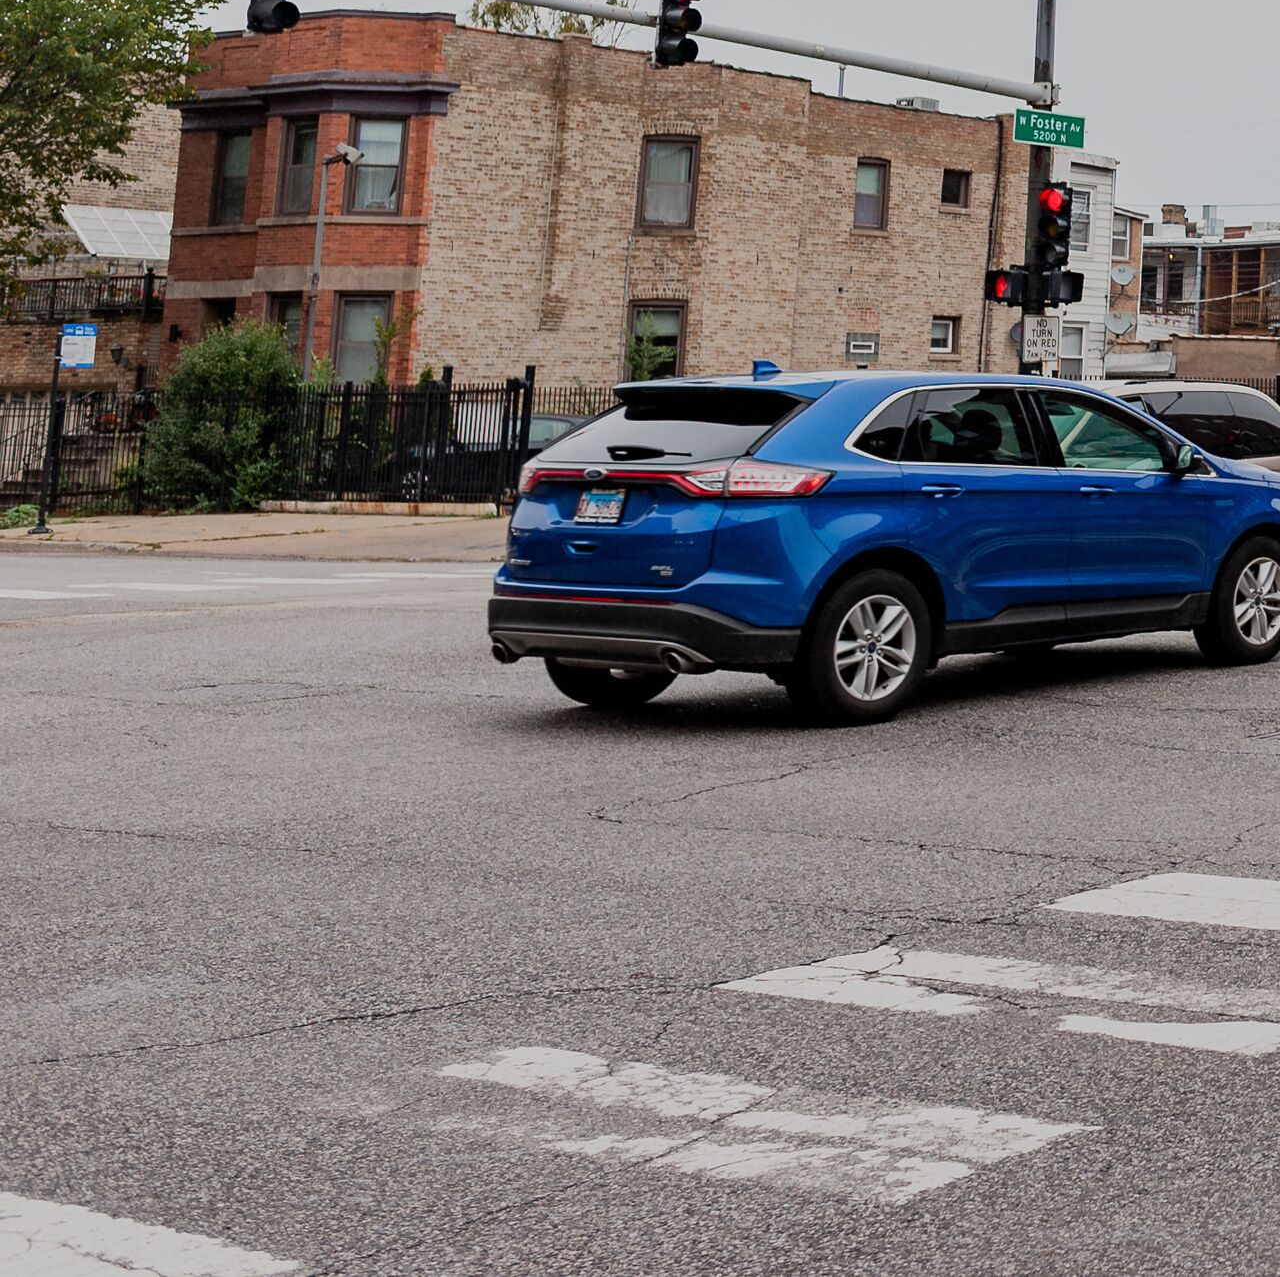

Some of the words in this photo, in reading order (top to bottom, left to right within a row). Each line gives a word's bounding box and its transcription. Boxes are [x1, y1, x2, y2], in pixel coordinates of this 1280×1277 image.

[1020, 116, 1027, 125] W
[1030, 114, 1068, 132] Foster
[1070, 123, 1081, 132] Av
[1034, 130, 1057, 141] 5200
[1060, 134, 1067, 143] N
[1036, 319, 1048, 328] NO
[1032, 329, 1053, 338] TURN
[1026, 339, 1038, 348] ON
[1041, 338, 1057, 348] RED
